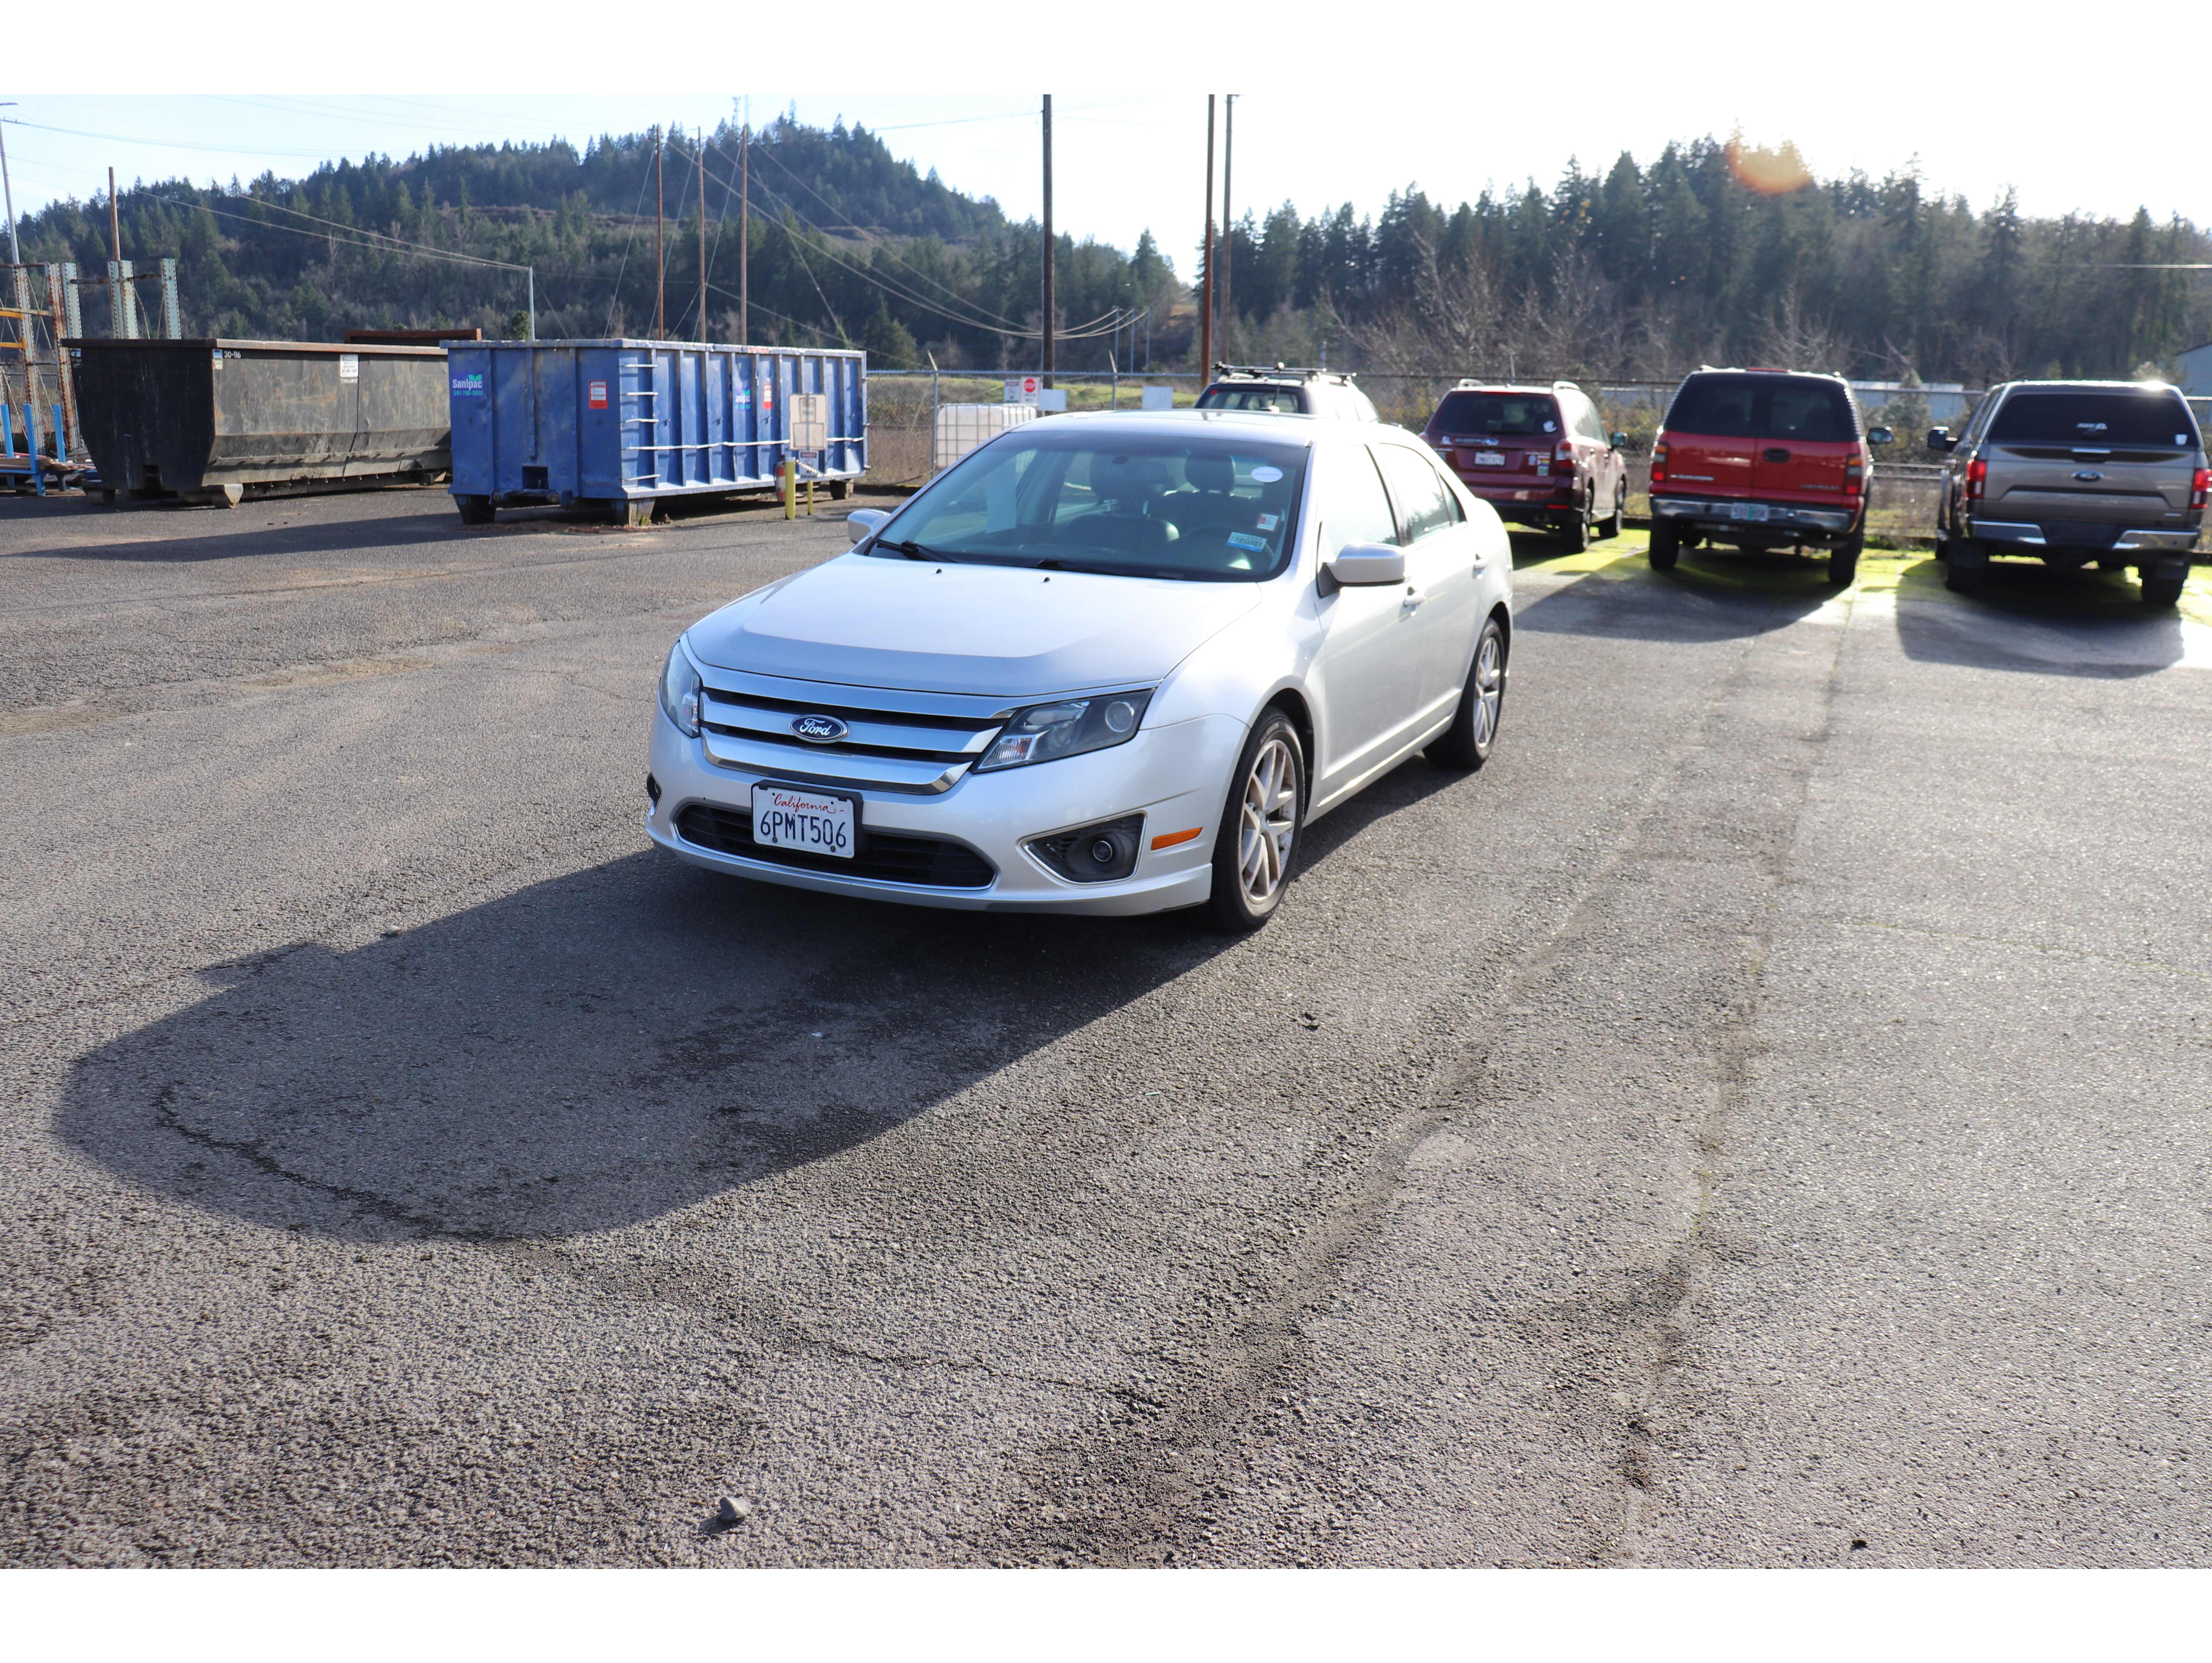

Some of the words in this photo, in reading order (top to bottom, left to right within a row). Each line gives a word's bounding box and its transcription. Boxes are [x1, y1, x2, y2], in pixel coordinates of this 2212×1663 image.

[224, 351, 241, 359] 30-116
[452, 379, 483, 390] Sanipac
[800, 719, 832, 735] Ford
[775, 794, 835, 814] California
[761, 810, 846, 848] 6PMT506
